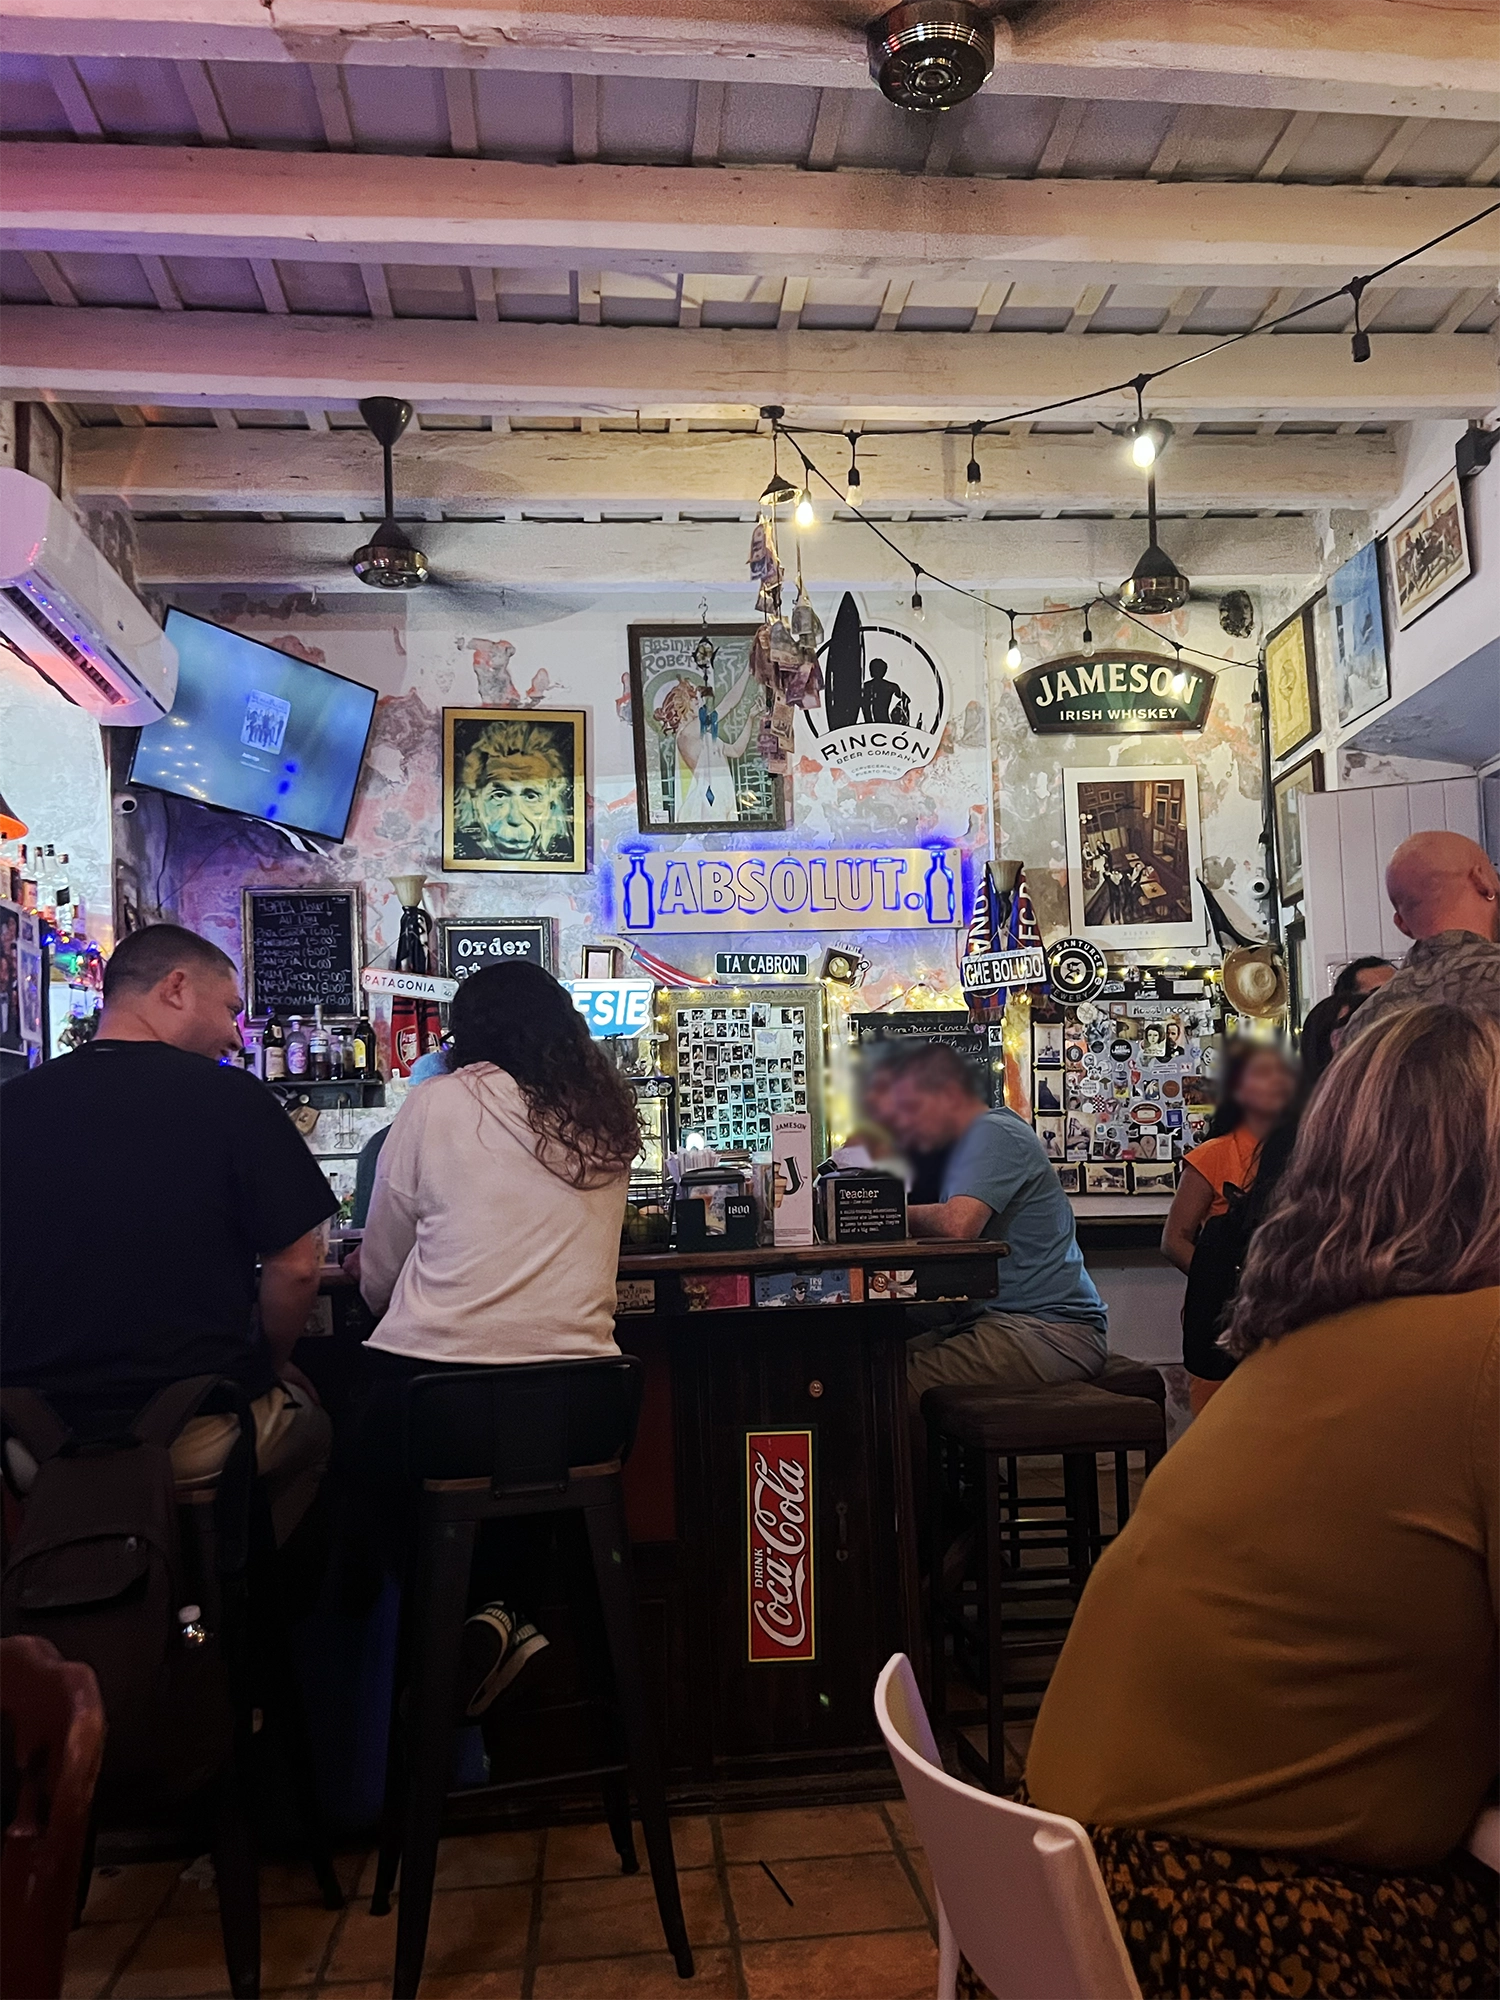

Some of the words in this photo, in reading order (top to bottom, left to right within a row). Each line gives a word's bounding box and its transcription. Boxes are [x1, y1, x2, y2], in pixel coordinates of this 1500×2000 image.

[642, 639, 700, 655] ABSINT
[642, 654, 704, 675] ROBET
[1035, 663, 1199, 707] JAMESON
[1060, 710, 1102, 721] IRISH
[1107, 708, 1178, 720] WHISKEY
[820, 731, 930, 761] RINCÓN
[836, 751, 863, 764] BEER
[867, 750, 917, 763] COMPANY
[855, 769, 881, 777] PUERTO
[457, 937, 531, 957] Order
[1055, 940, 1103, 967] SANTURCE
[455, 962, 481, 979] at
[723, 955, 746, 973] TA'
[748, 955, 800, 974] CABRON
[992, 955, 1042, 982] BOLUDO
[364, 975, 435, 993] PATAGONIA
[910, 1024, 932, 1033] Beer
[938, 1023, 970, 1032] Cerveza
[775, 1122, 807, 1131] JAMESON
[839, 1187, 879, 1199] Teacher
[728, 1205, 750, 1215] 1800
[753, 1450, 806, 1647] Coca-Cola
[754, 1548, 764, 1588] DRINK
